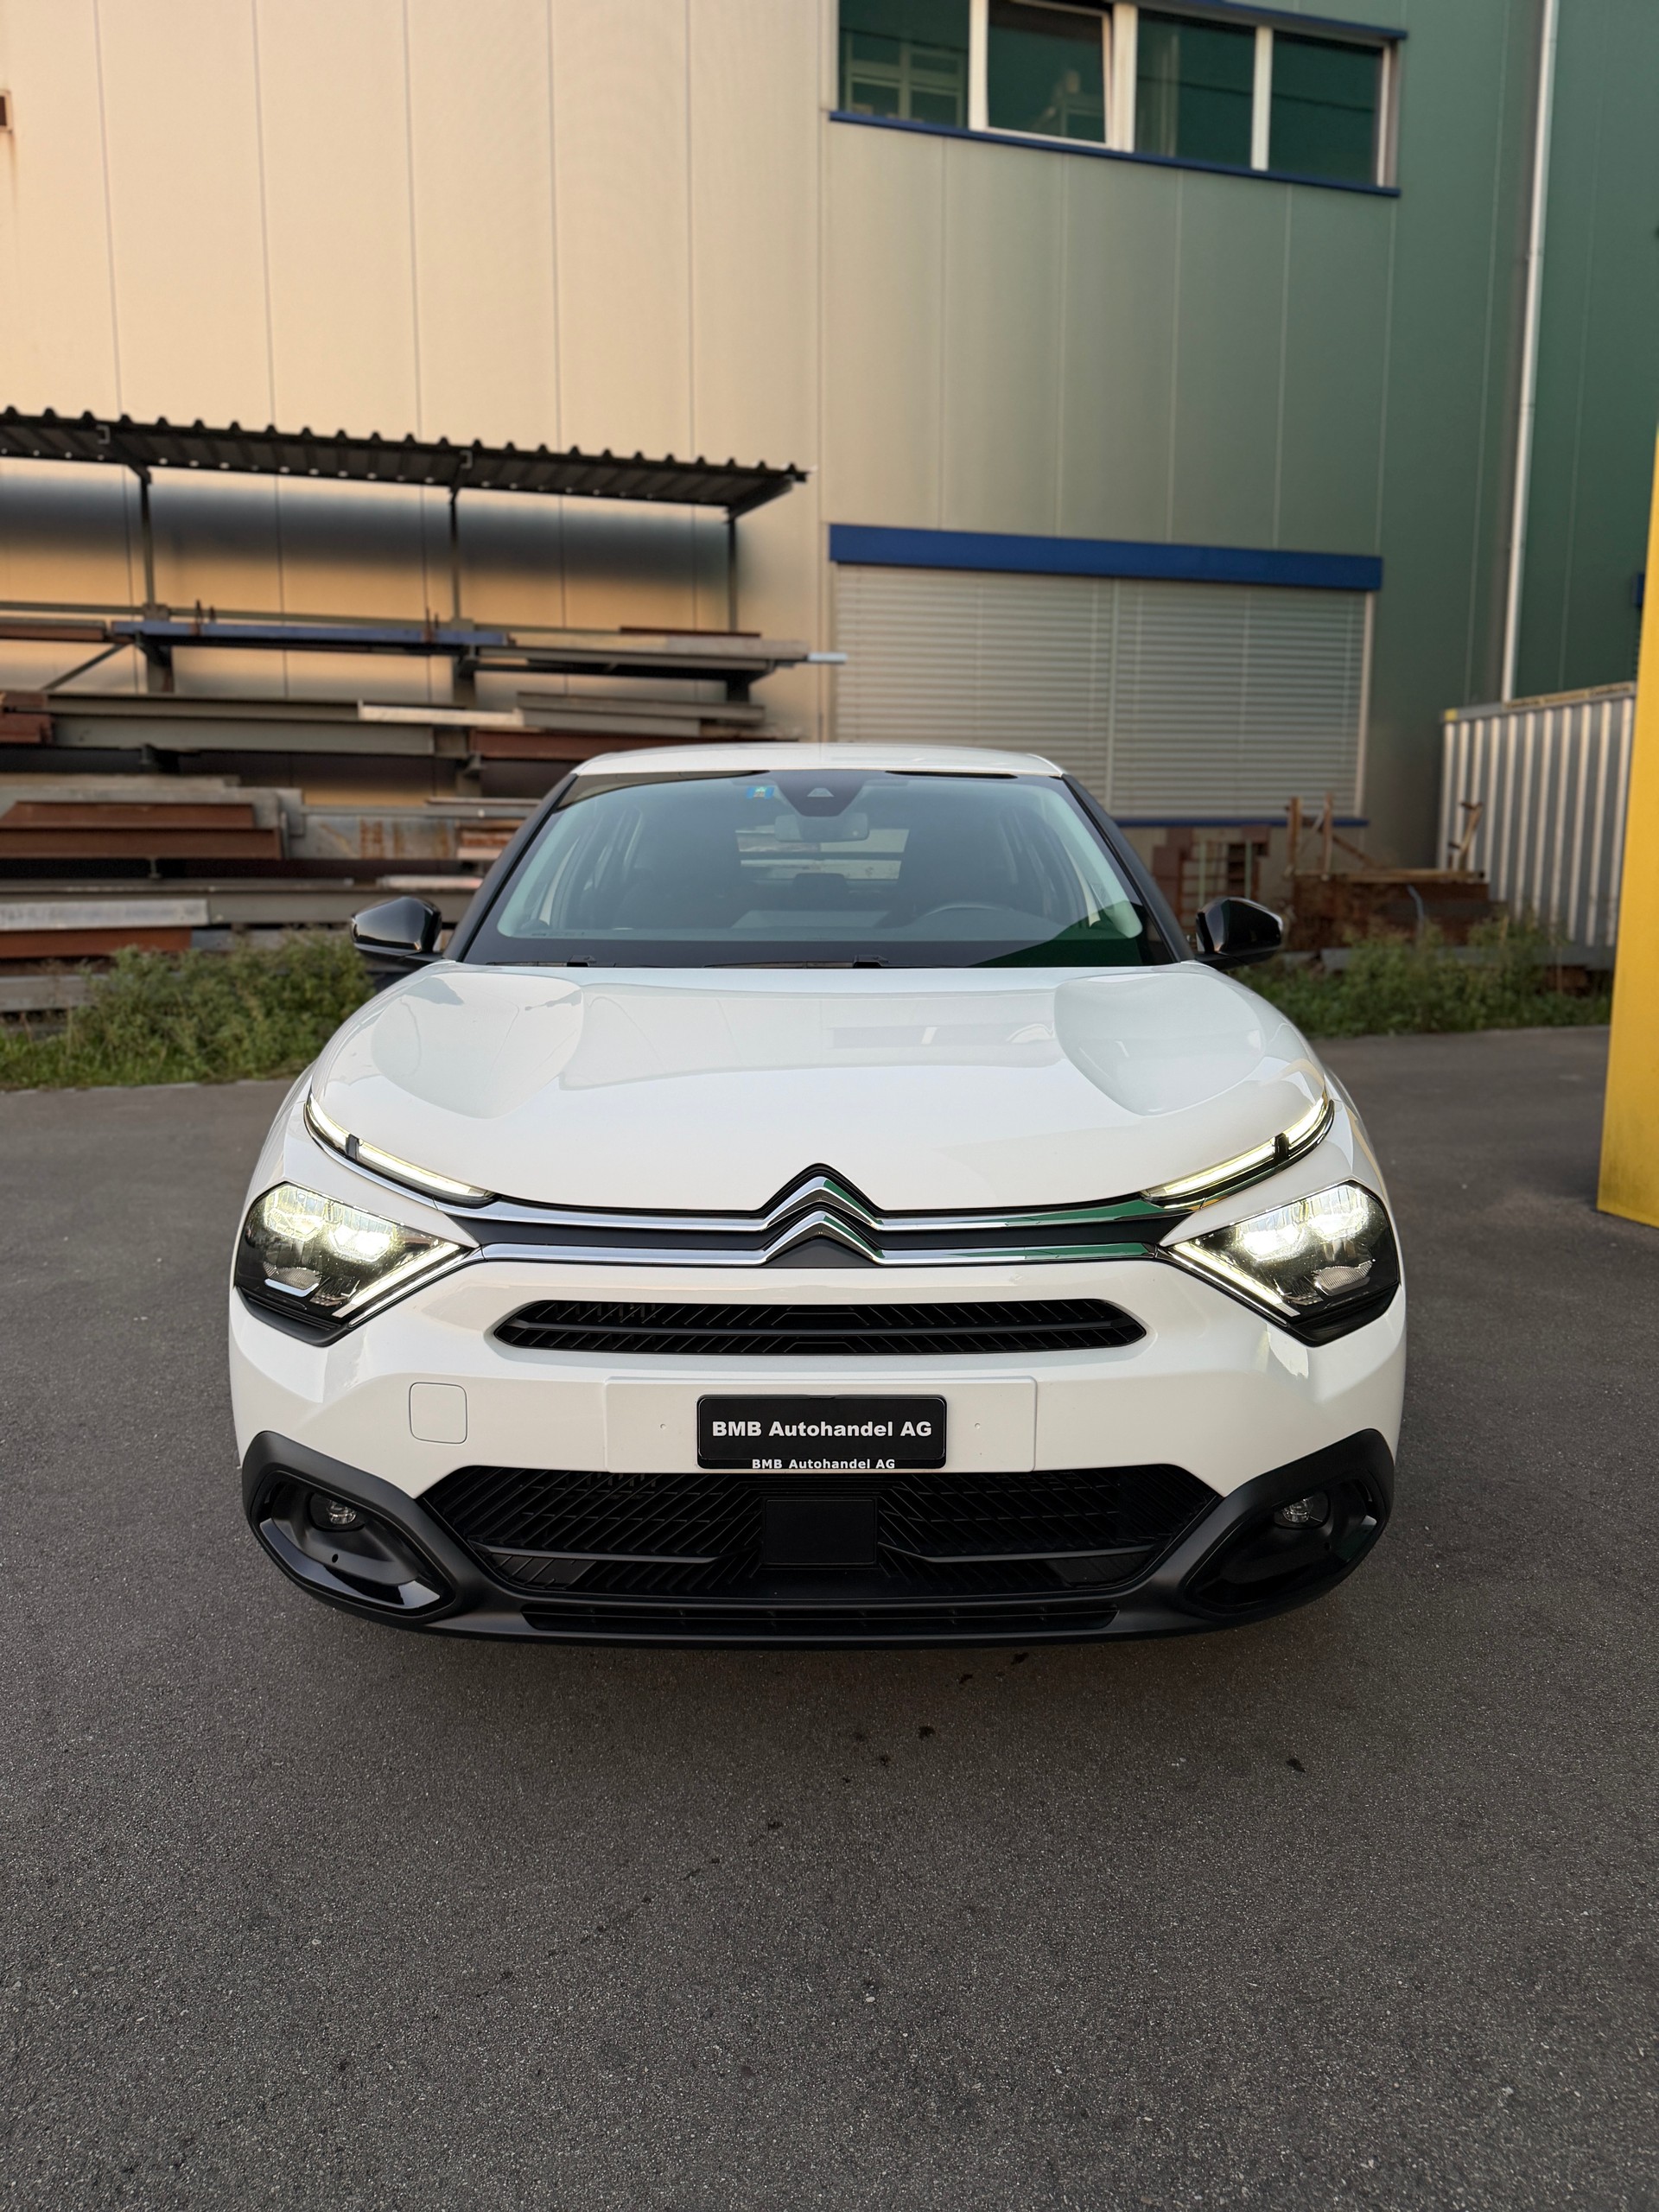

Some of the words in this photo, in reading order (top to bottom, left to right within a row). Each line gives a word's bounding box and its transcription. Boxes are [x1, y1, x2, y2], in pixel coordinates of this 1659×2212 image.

[712, 1421, 762, 1437] BMB
[768, 1421, 893, 1437] Autohandel
[899, 1421, 932, 1437] AG
[752, 1459, 783, 1469] BMB
[788, 1459, 871, 1469] Autohandel
[875, 1459, 895, 1469] AG
